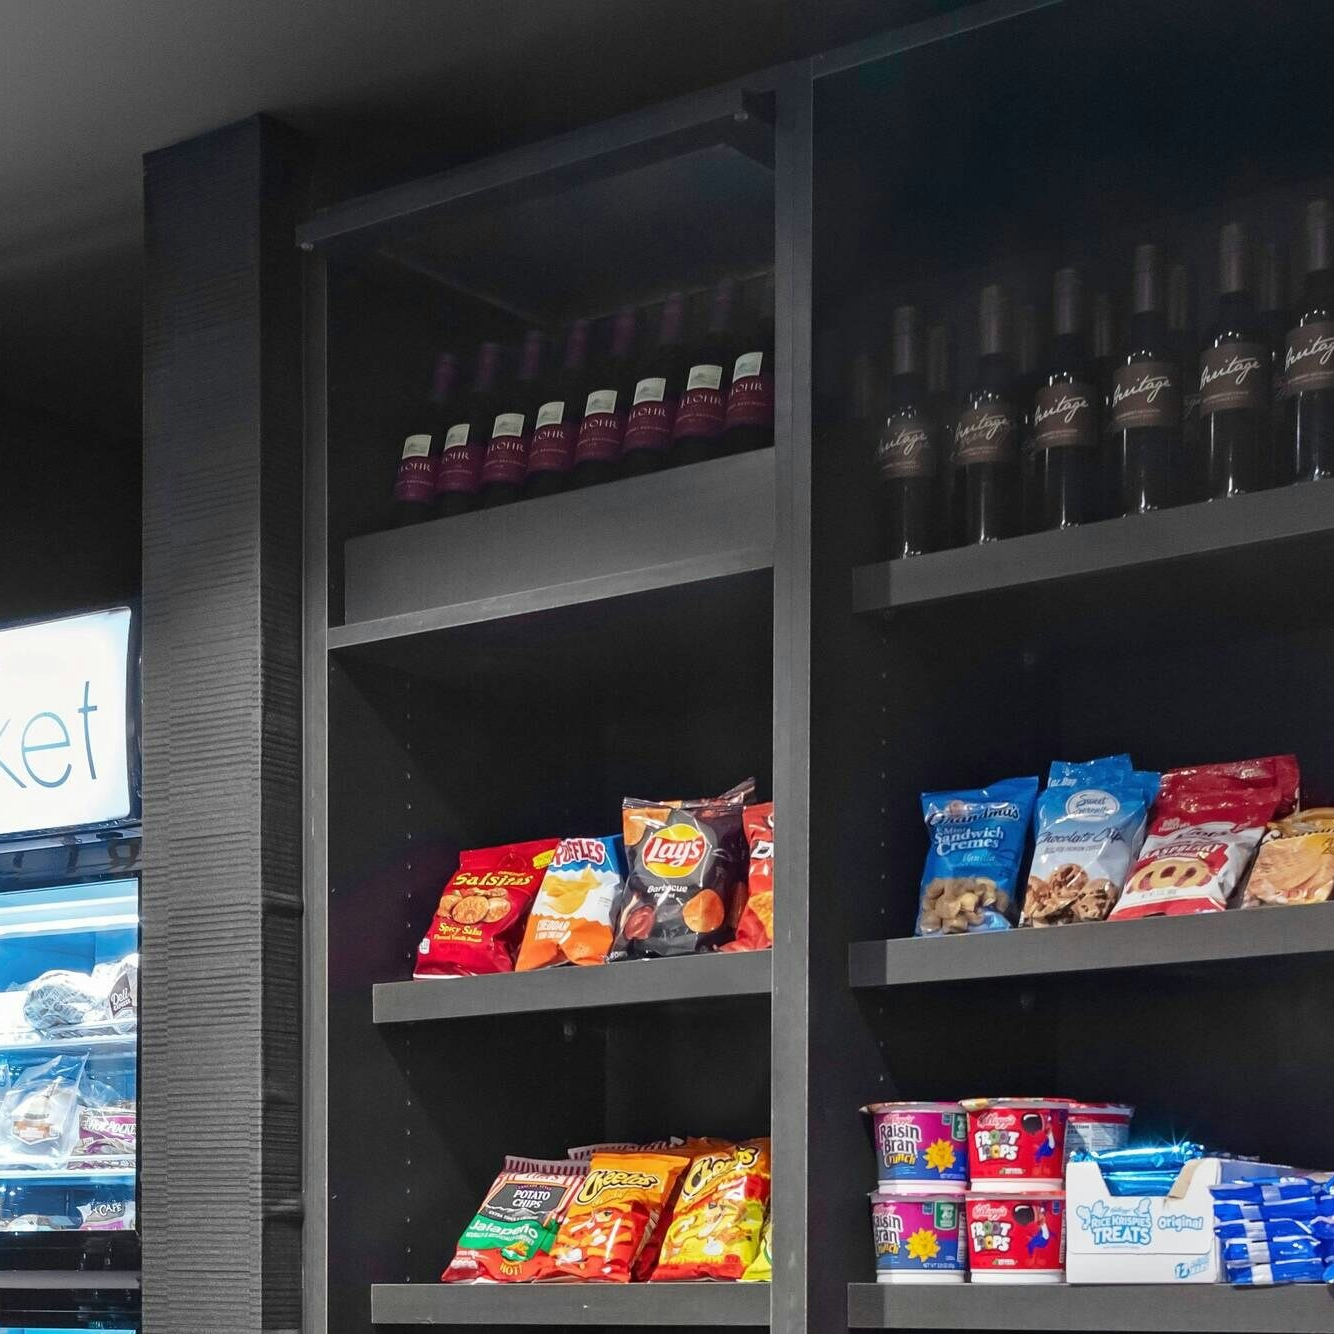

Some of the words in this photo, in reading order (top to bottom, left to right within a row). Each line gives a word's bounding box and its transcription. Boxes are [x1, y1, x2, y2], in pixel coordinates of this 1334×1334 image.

[934, 826, 1004, 845] Sandwich
[554, 838, 605, 866] RUFFLES
[937, 838, 1000, 857] Cremes
[452, 871, 534, 888] Salsitas
[880, 1123, 920, 1139] Raisin
[884, 1138, 916, 1153] Bran
[513, 1189, 551, 1202] POTATO
[576, 1170, 660, 1205] Cheetos
[512, 1199, 541, 1210] CHIPS
[469, 1219, 539, 1239] Jalapeño
[1091, 1216, 1111, 1229] RICE
[1111, 1215, 1152, 1230] KRISPIES
[1158, 1216, 1204, 1233] Original
[1094, 1227, 1151, 1245] TREATS
